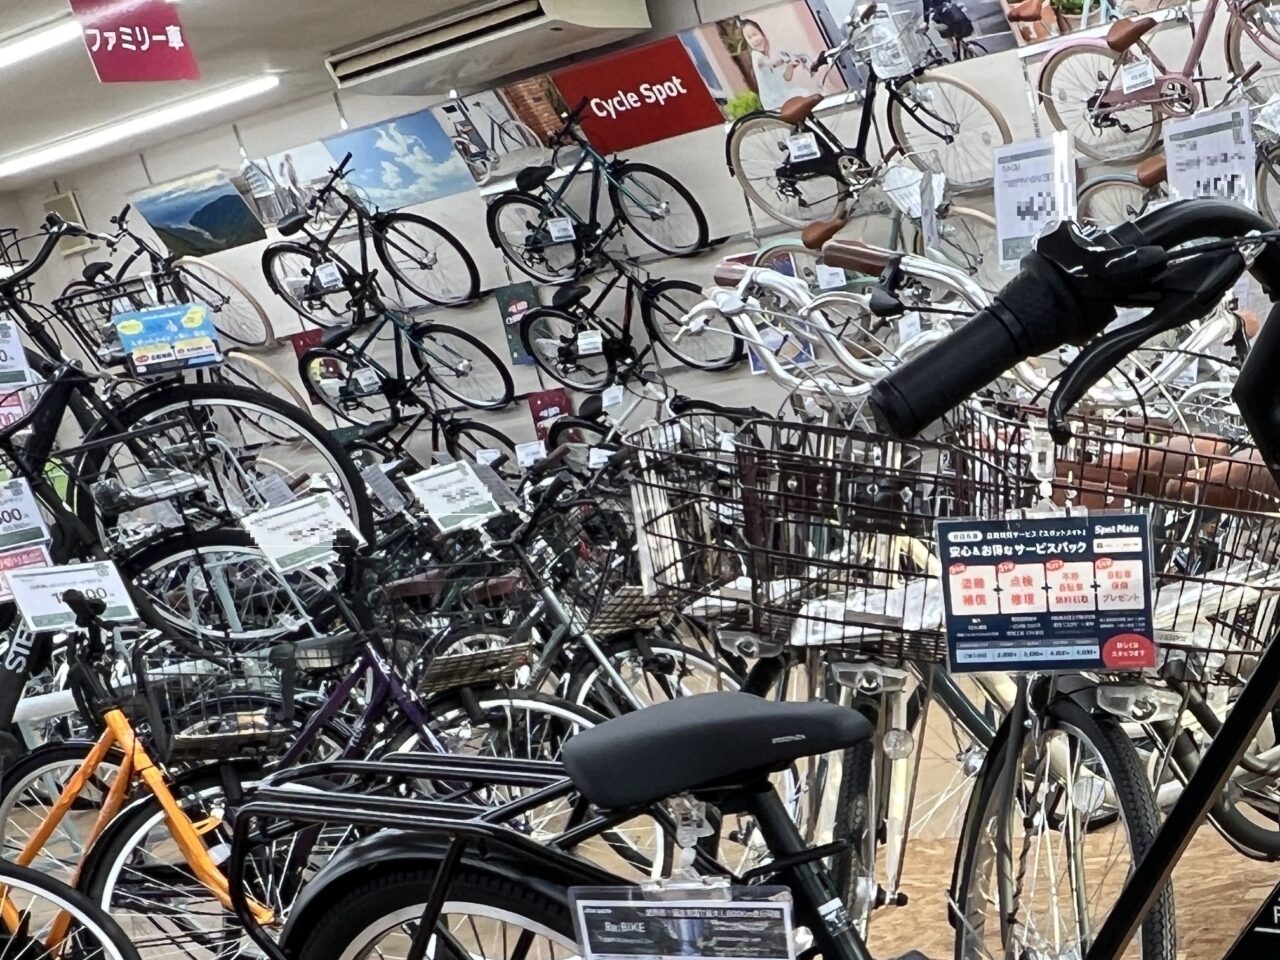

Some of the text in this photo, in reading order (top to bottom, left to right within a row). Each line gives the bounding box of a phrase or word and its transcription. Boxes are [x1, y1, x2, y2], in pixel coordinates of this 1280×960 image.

[85, 25, 185, 52] ファミリー車
[590, 75, 688, 120] Cycle Spot
